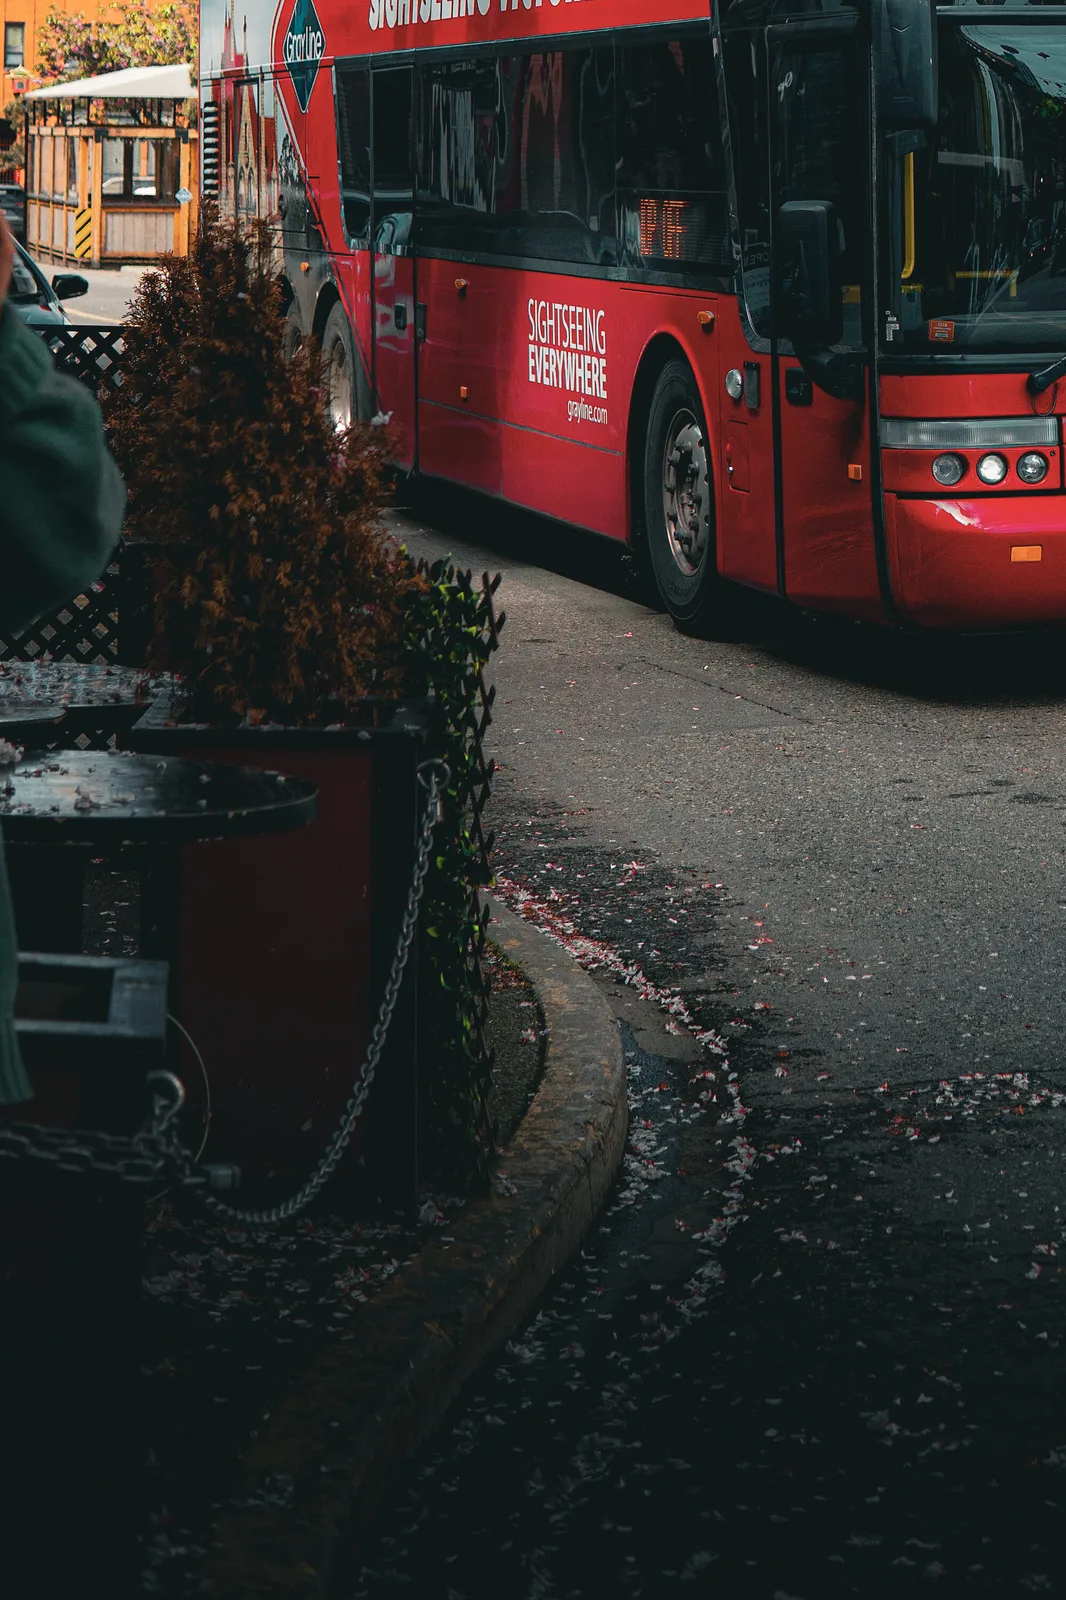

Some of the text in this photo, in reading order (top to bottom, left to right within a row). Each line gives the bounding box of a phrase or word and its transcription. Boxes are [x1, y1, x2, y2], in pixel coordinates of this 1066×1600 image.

[528, 298, 606, 355] SIGHTSEEING
[528, 344, 607, 399] EVERYWHERE
[567, 397, 608, 425] grayline.com
